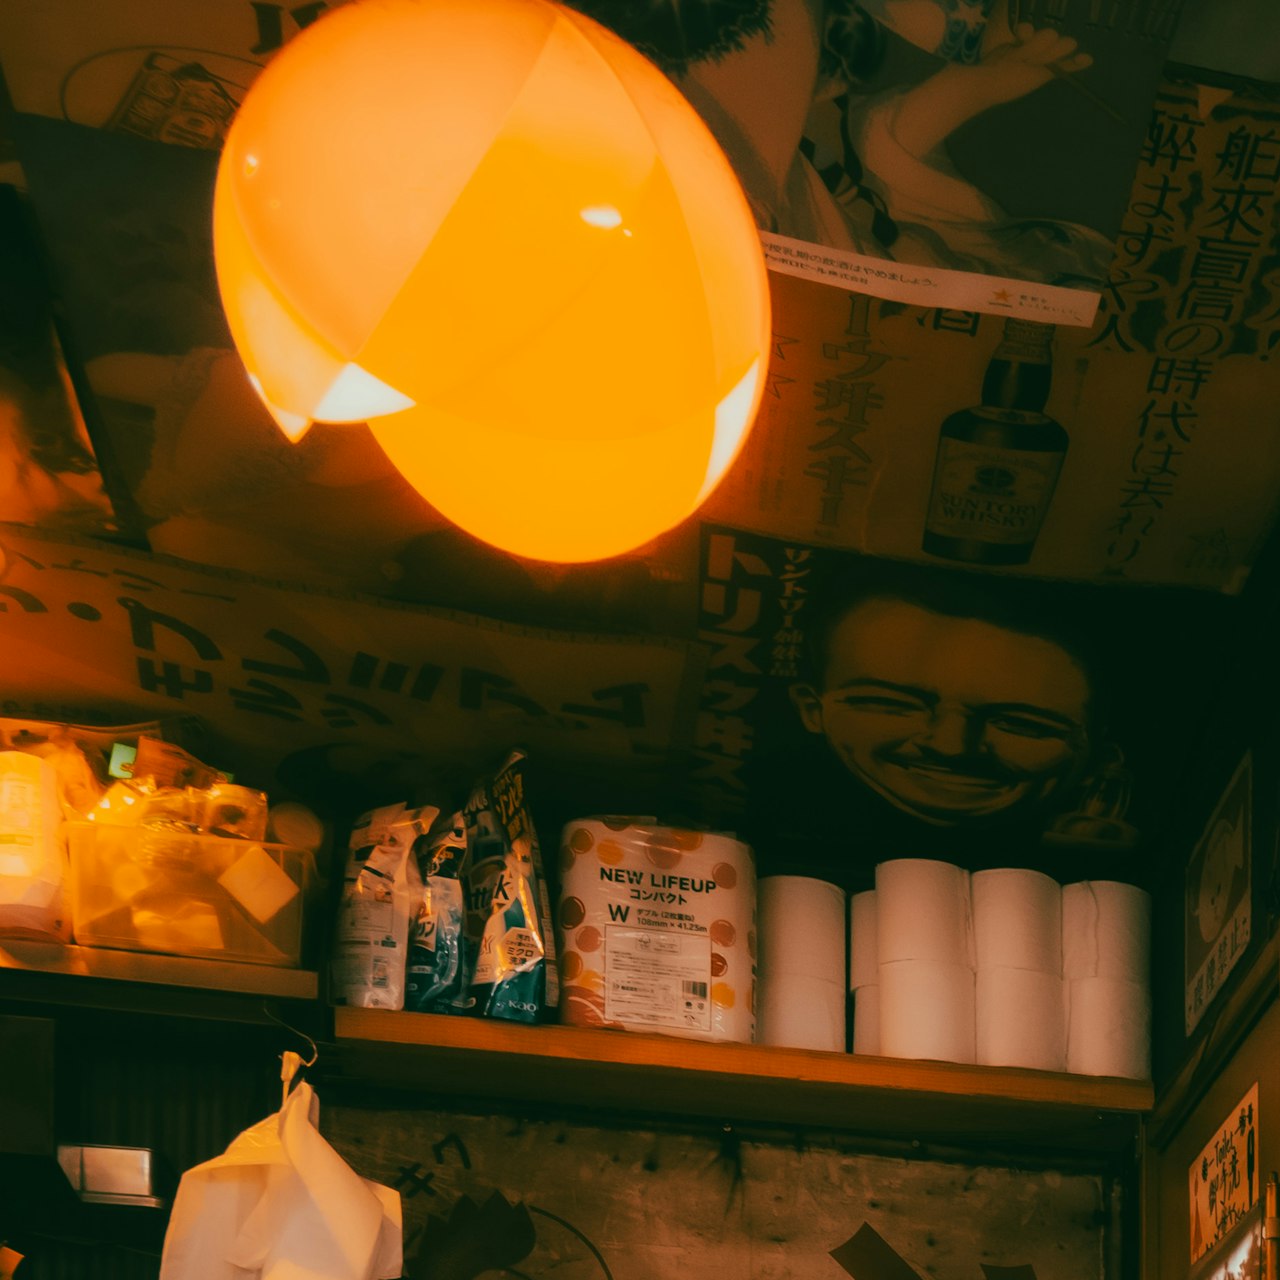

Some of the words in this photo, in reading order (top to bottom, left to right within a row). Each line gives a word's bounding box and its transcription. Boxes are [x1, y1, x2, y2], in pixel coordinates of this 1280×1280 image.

[599, 866, 644, 885] NEW
[650, 873, 717, 895] LIFEUP
[629, 887, 689, 906] コンパクト
[608, 903, 631, 924] W
